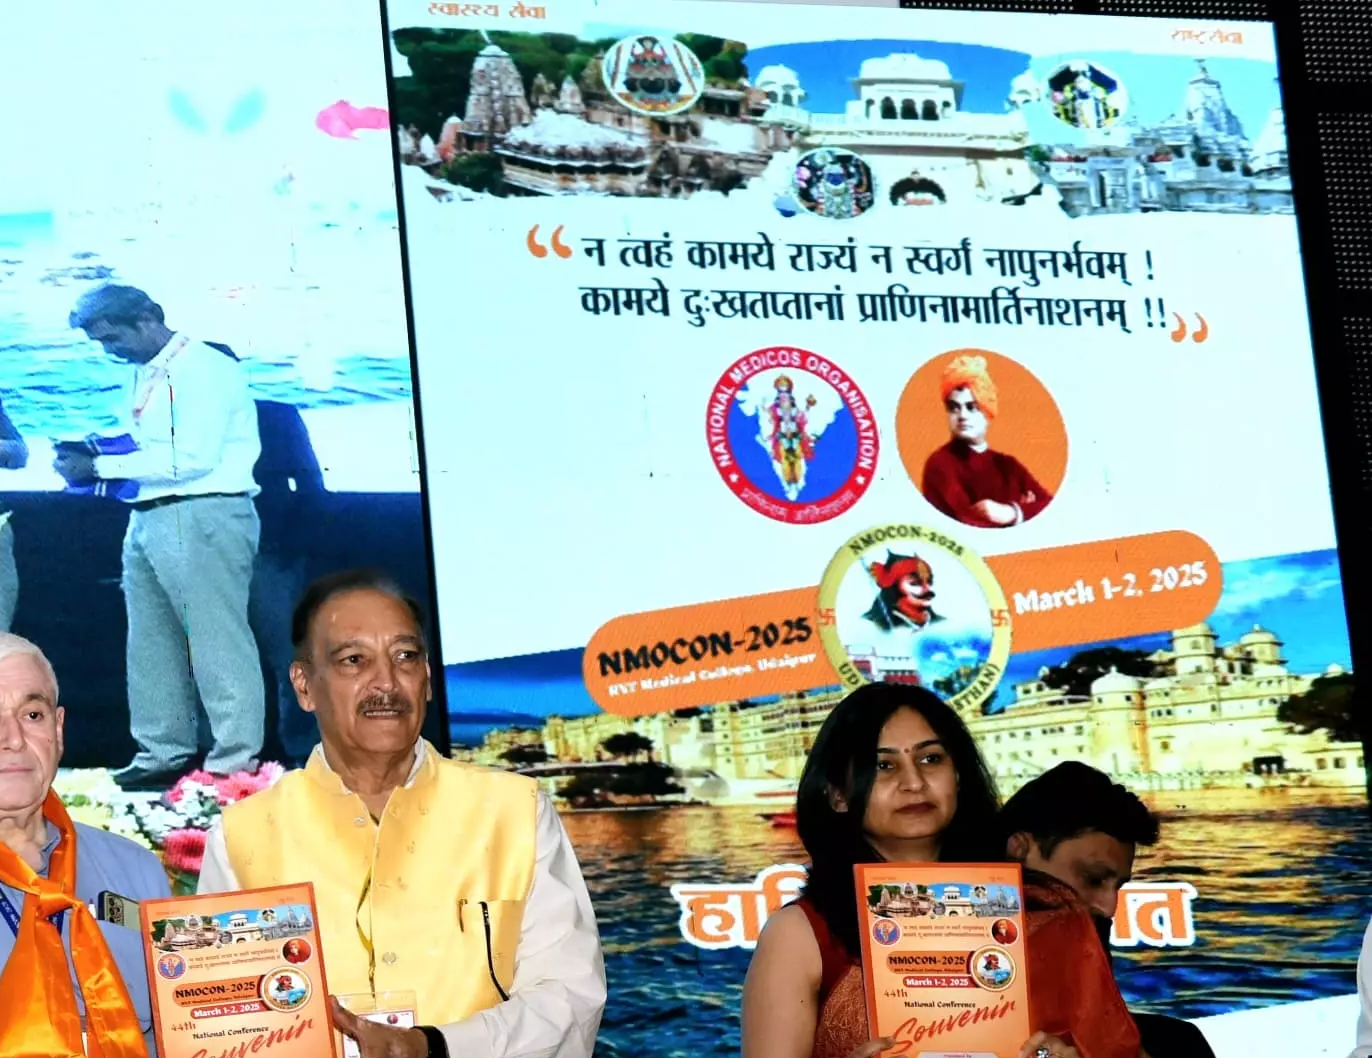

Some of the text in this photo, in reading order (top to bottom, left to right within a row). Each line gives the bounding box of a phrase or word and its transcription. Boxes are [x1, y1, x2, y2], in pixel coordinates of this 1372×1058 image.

[509, 1, 546, 20] सेवा
[581, 238, 606, 267] न
[616, 232, 673, 268] त्वहं
[684, 232, 776, 271] कामये
[786, 236, 858, 273] राज्यं
[868, 245, 893, 273] न
[983, 240, 1132, 287] नापुनर्भवम्
[578, 277, 671, 317] कामये
[680, 284, 845, 327] दुःखतप्तानां
[856, 283, 1132, 334] प्राणिनामार्तिनाशनम्
[710, 349, 875, 470] NATIONAL MEDICOS ORGANISATION
[849, 524, 964, 557] NMOCON-2025
[1012, 578, 1095, 615] March
[1150, 560, 1208, 593] 2025
[599, 616, 813, 677] NMOCON-2025
[640, 671, 696, 691] Medical
[889, 956, 966, 966] NMOCON-2025
[176, 981, 256, 998] NMOCON-2025
[906, 978, 932, 986] March
[193, 1008, 222, 1017] March
[240, 1003, 260, 1012] 2025
[192, 1025, 269, 1040] National Conference
[890, 994, 1016, 1055] Souvenir
